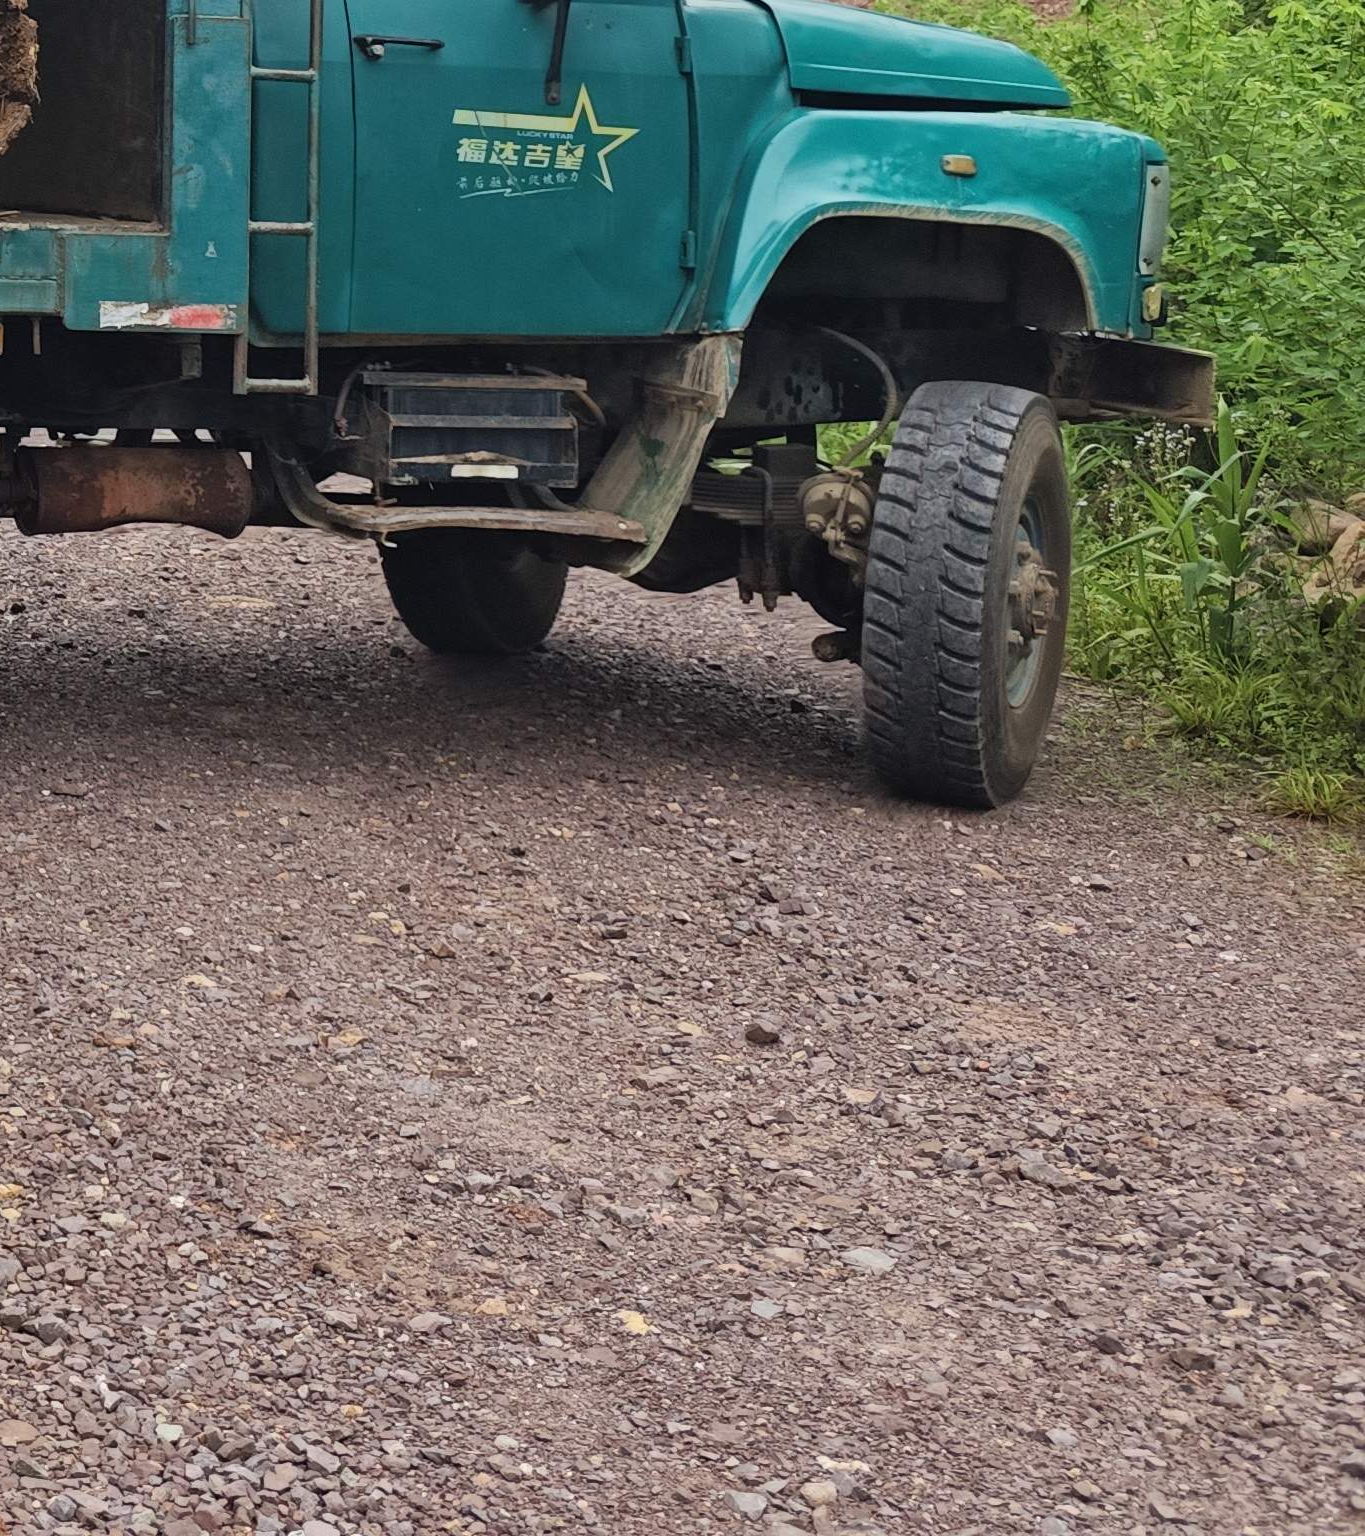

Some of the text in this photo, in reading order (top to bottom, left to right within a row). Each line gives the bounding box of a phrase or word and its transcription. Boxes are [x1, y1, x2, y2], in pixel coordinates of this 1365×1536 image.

[516, 130, 574, 140] LUCKY STAR
[456, 138, 586, 170] 福达吉星
